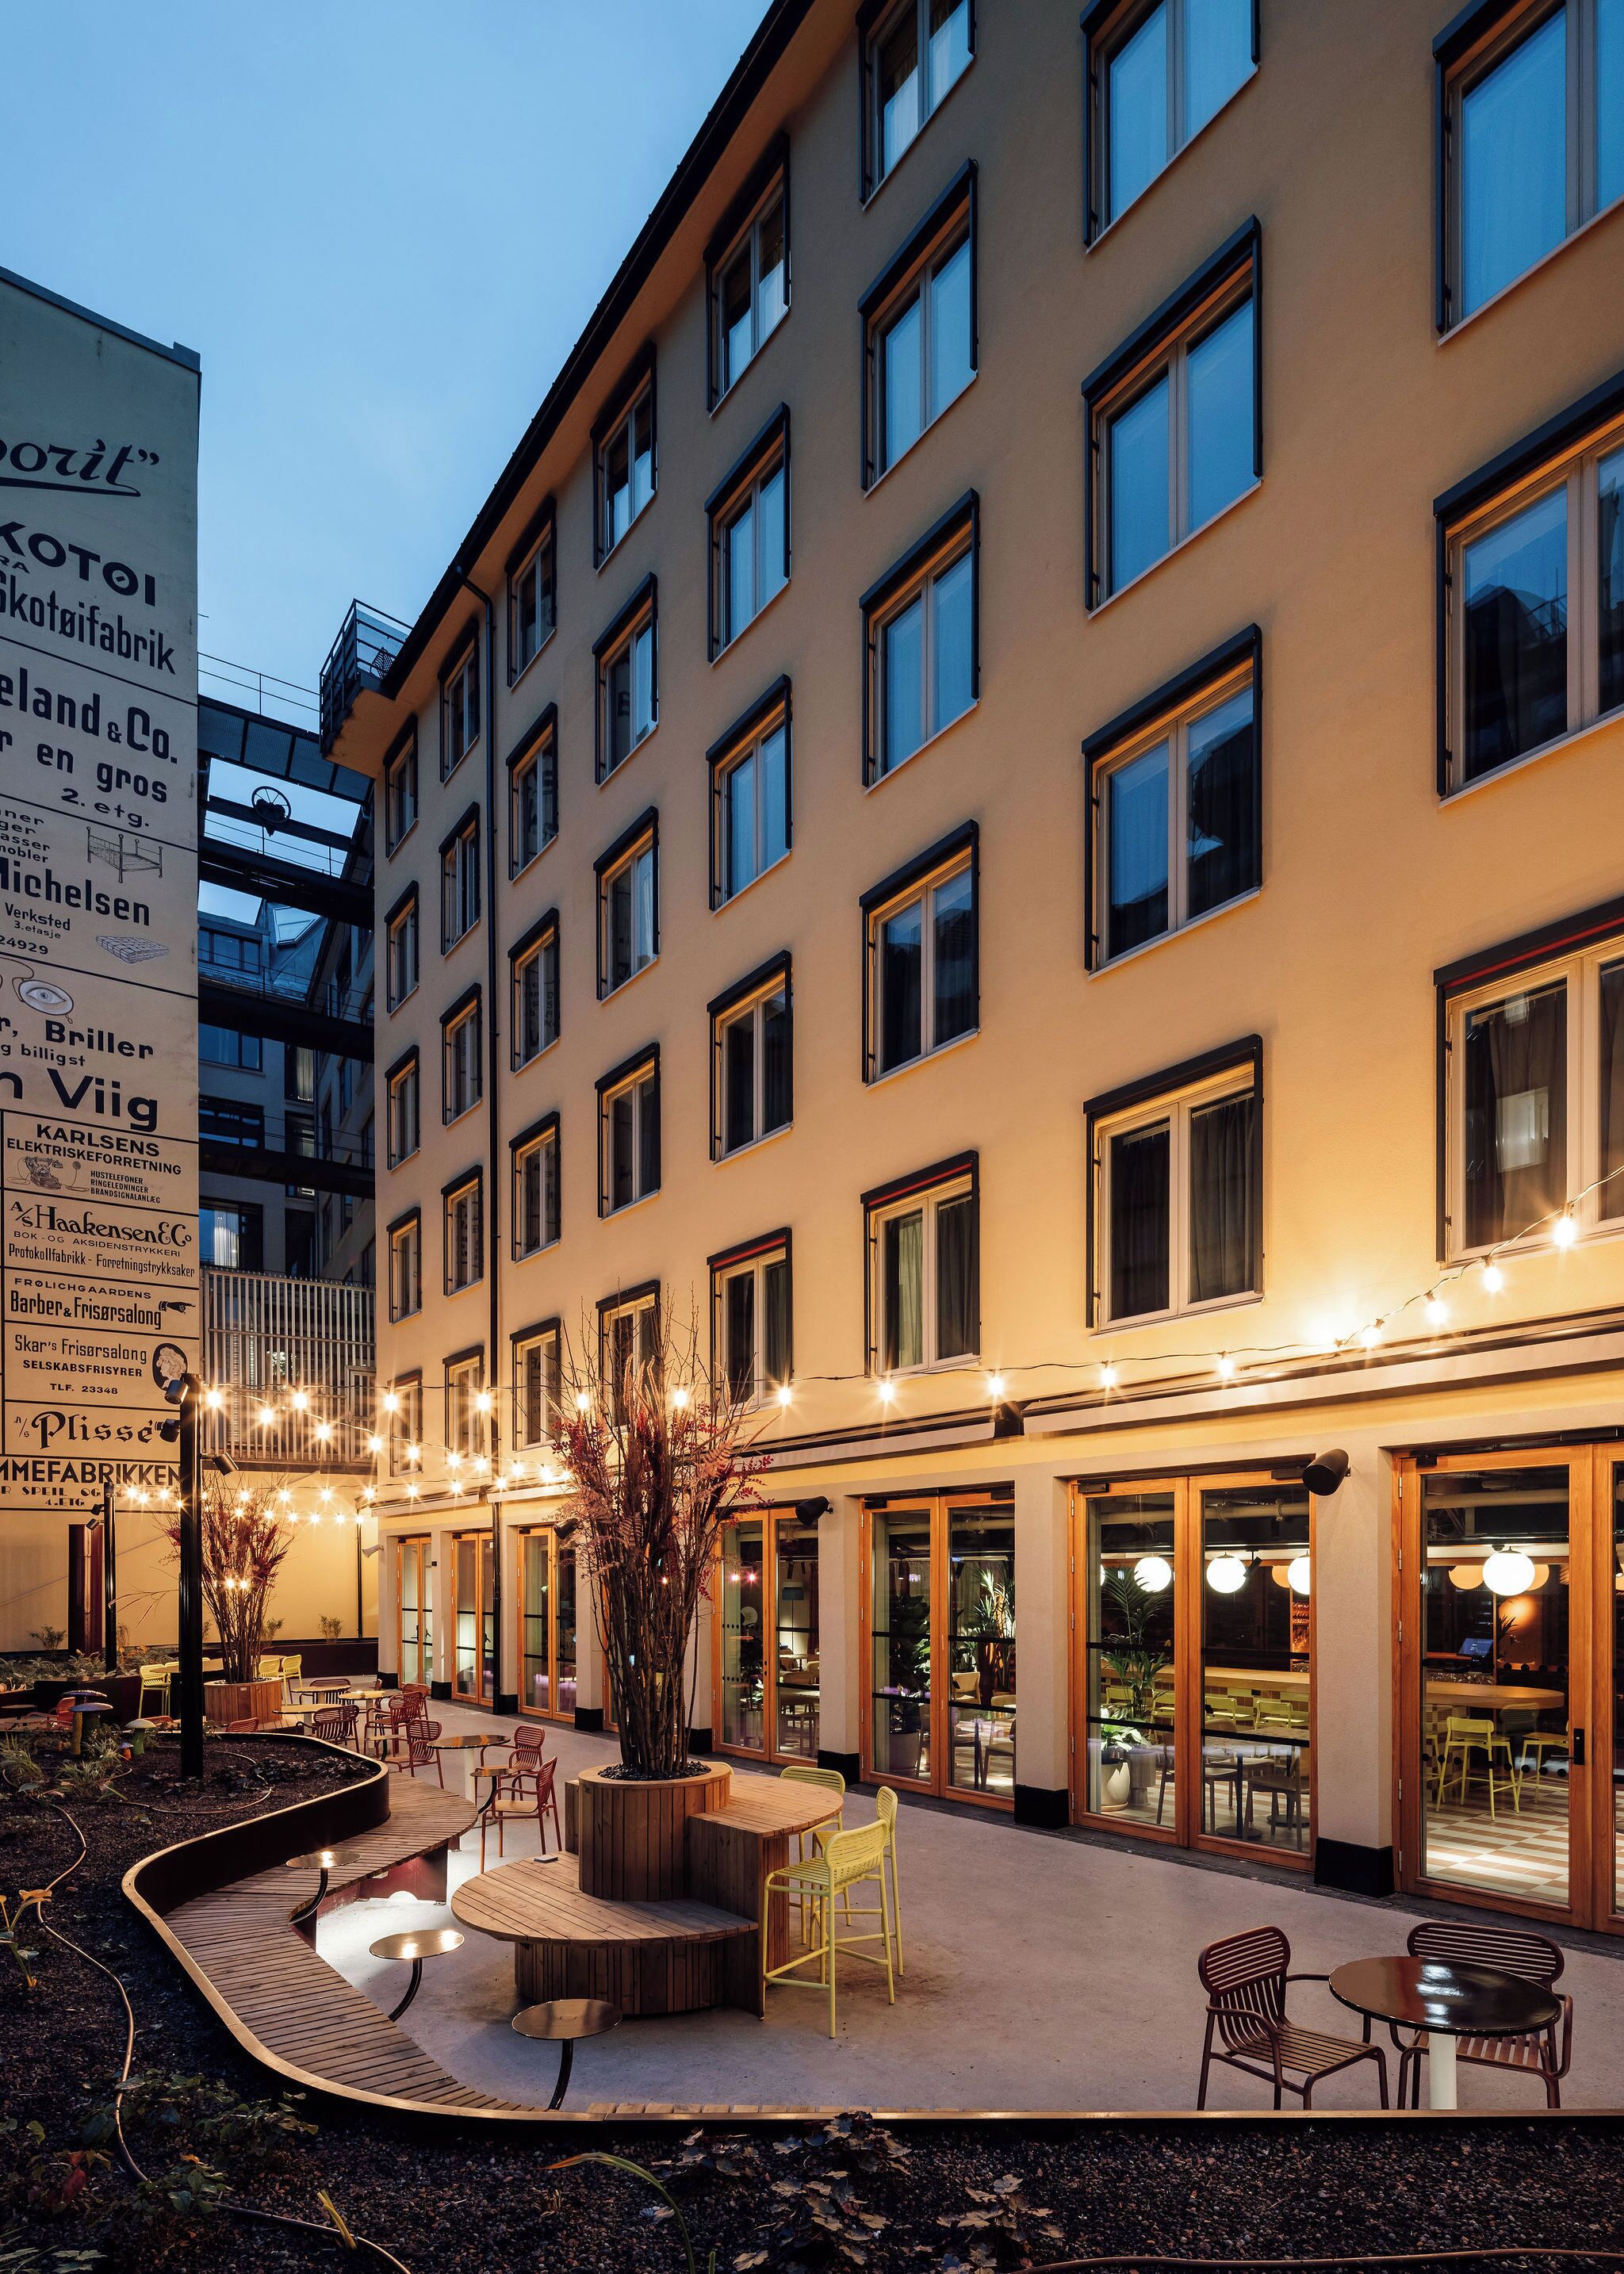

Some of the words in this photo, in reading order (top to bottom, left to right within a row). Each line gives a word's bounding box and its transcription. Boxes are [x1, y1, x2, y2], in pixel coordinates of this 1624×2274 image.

[37, 744, 74, 774] en
[97, 763, 167, 803] gros
[0, 810, 44, 825] ner
[0, 856, 150, 926] ichelsen
[5, 902, 71, 931] Verksted
[45, 1020, 154, 1059] Briller
[21, 1043, 86, 1066] billigst
[47, 1068, 158, 1133] Viig
[36, 1124, 159, 1157] KARLSENS
[7, 1137, 182, 1175] ELEKTRISKEFORRETNING
[90, 1170, 144, 1185] HUSTELEFONER
[90, 1179, 148, 1193] RINGELEDNINGER
[90, 1187, 160, 1204] BRANDSIGNALANLÆG
[73, 1238, 181, 1258] AKSIDENSTRYKKERI
[9, 1243, 86, 1265] Protokollfabrikk
[96, 1254, 195, 1278] Forretningstrykksaker
[15, 1278, 151, 1300] FRØLICHGAARDENS
[62, 1338, 147, 1365] Frisørsalong
[23, 1360, 143, 1377] SELSKABSFRISYRER
[50, 1383, 75, 1392] TLF.
[82, 1385, 118, 1395] 23348
[22, 1487, 67, 1496] SPEIL
[81, 1488, 101, 1497] OG
